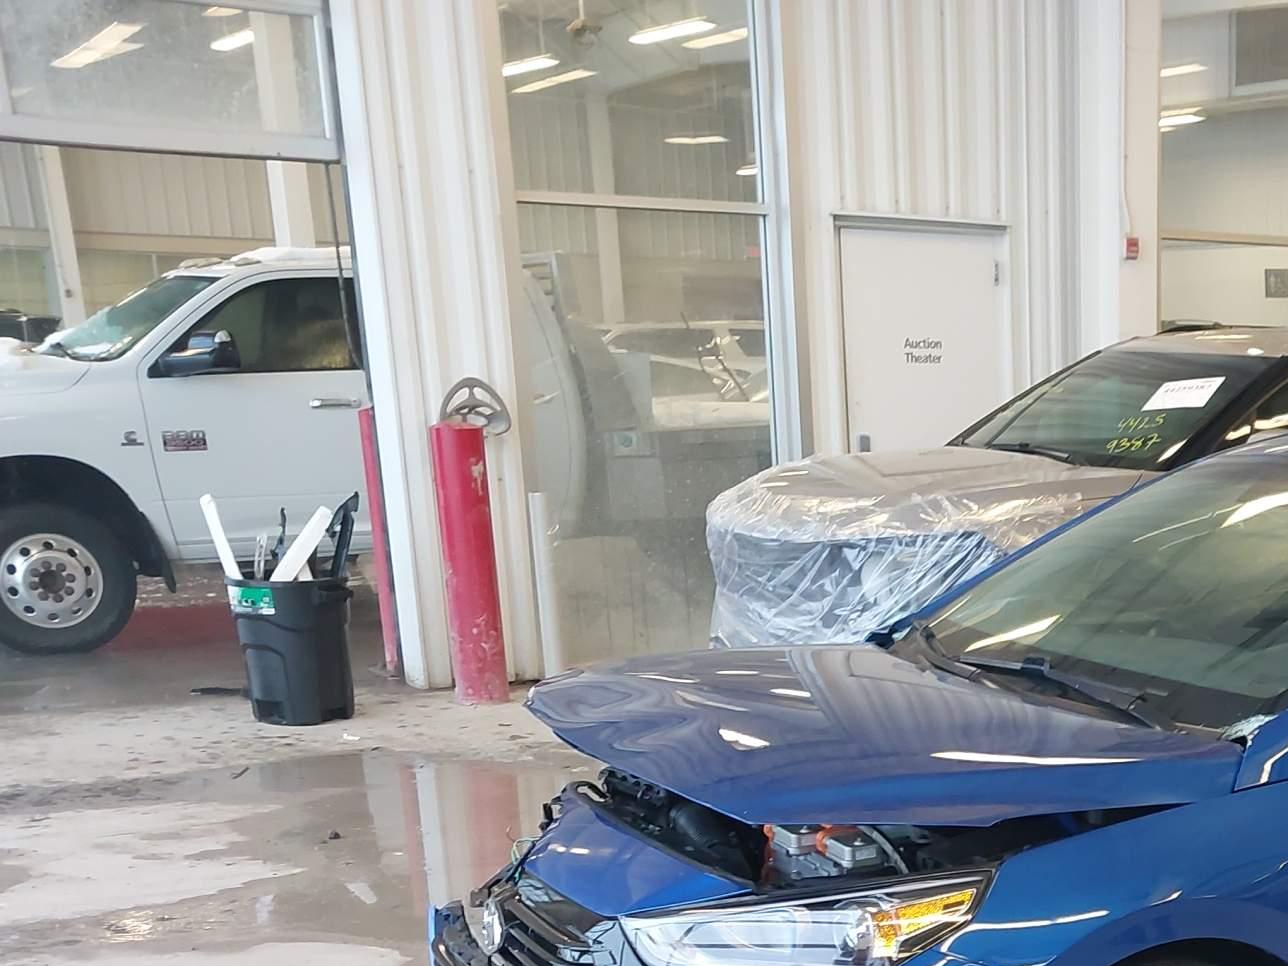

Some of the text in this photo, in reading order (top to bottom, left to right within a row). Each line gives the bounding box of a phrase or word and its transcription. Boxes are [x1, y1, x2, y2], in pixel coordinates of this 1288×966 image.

[903, 337, 943, 349] Auction
[903, 352, 942, 364] Theater
[1106, 433, 1161, 454] 9387
